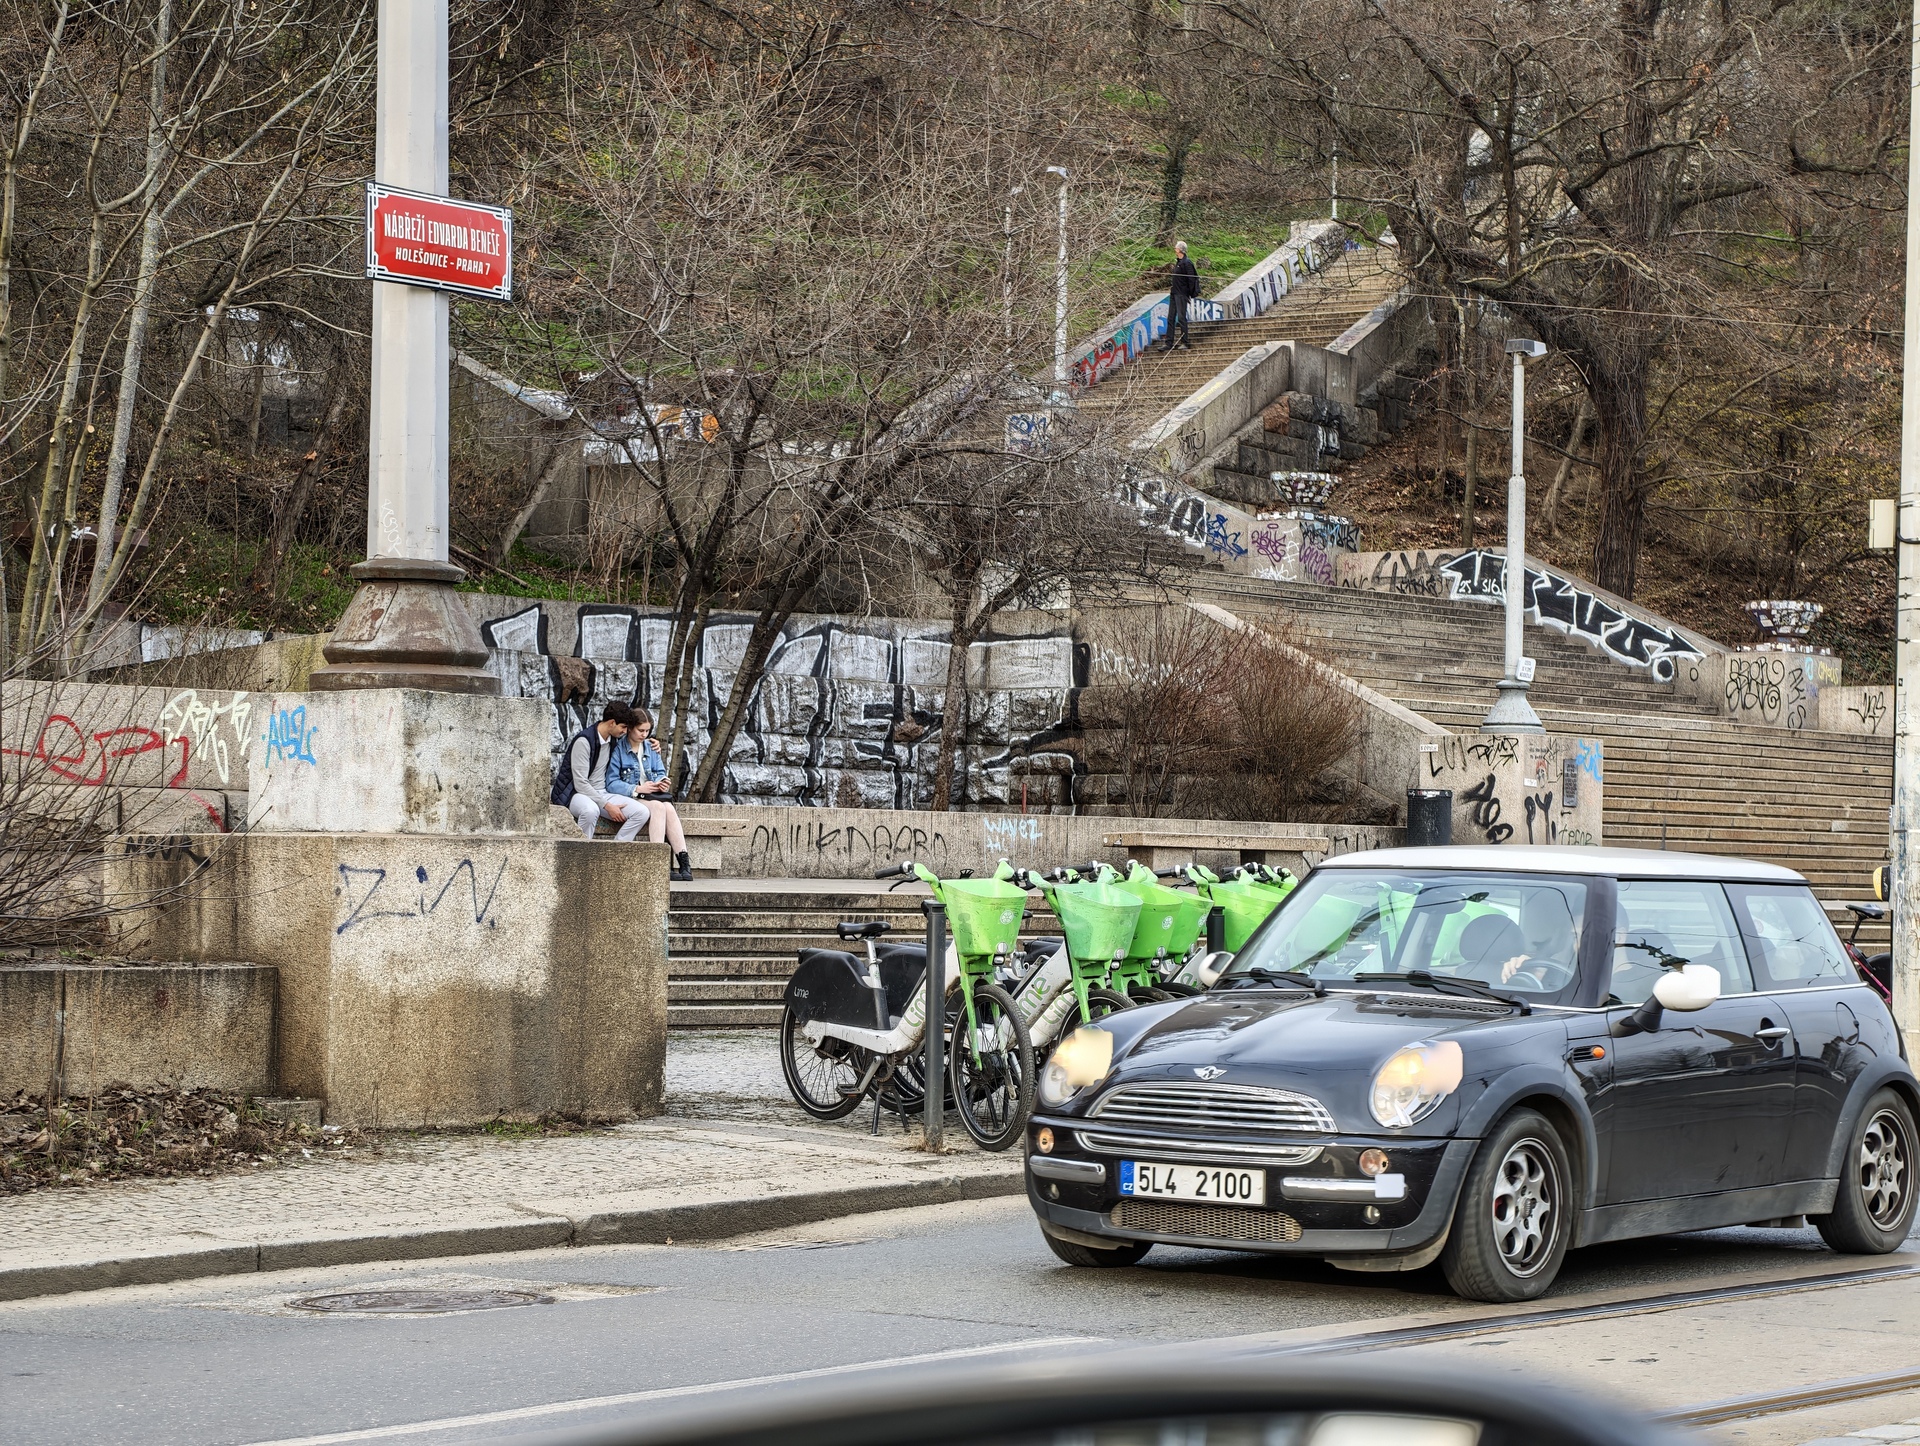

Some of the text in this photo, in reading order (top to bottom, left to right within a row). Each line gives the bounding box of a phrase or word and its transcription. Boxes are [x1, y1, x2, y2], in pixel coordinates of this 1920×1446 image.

[384, 210, 500, 257] NÁBŘEŽÍ EDVARDA BENEŠE
[395, 247, 448, 268] HOLEŠOVICE
[456, 258, 483, 275] PRAHA
[485, 262, 491, 275] 7
[794, 986, 810, 999] Lime
[1122, 1165, 1252, 1200] CZ 5L4 2100
